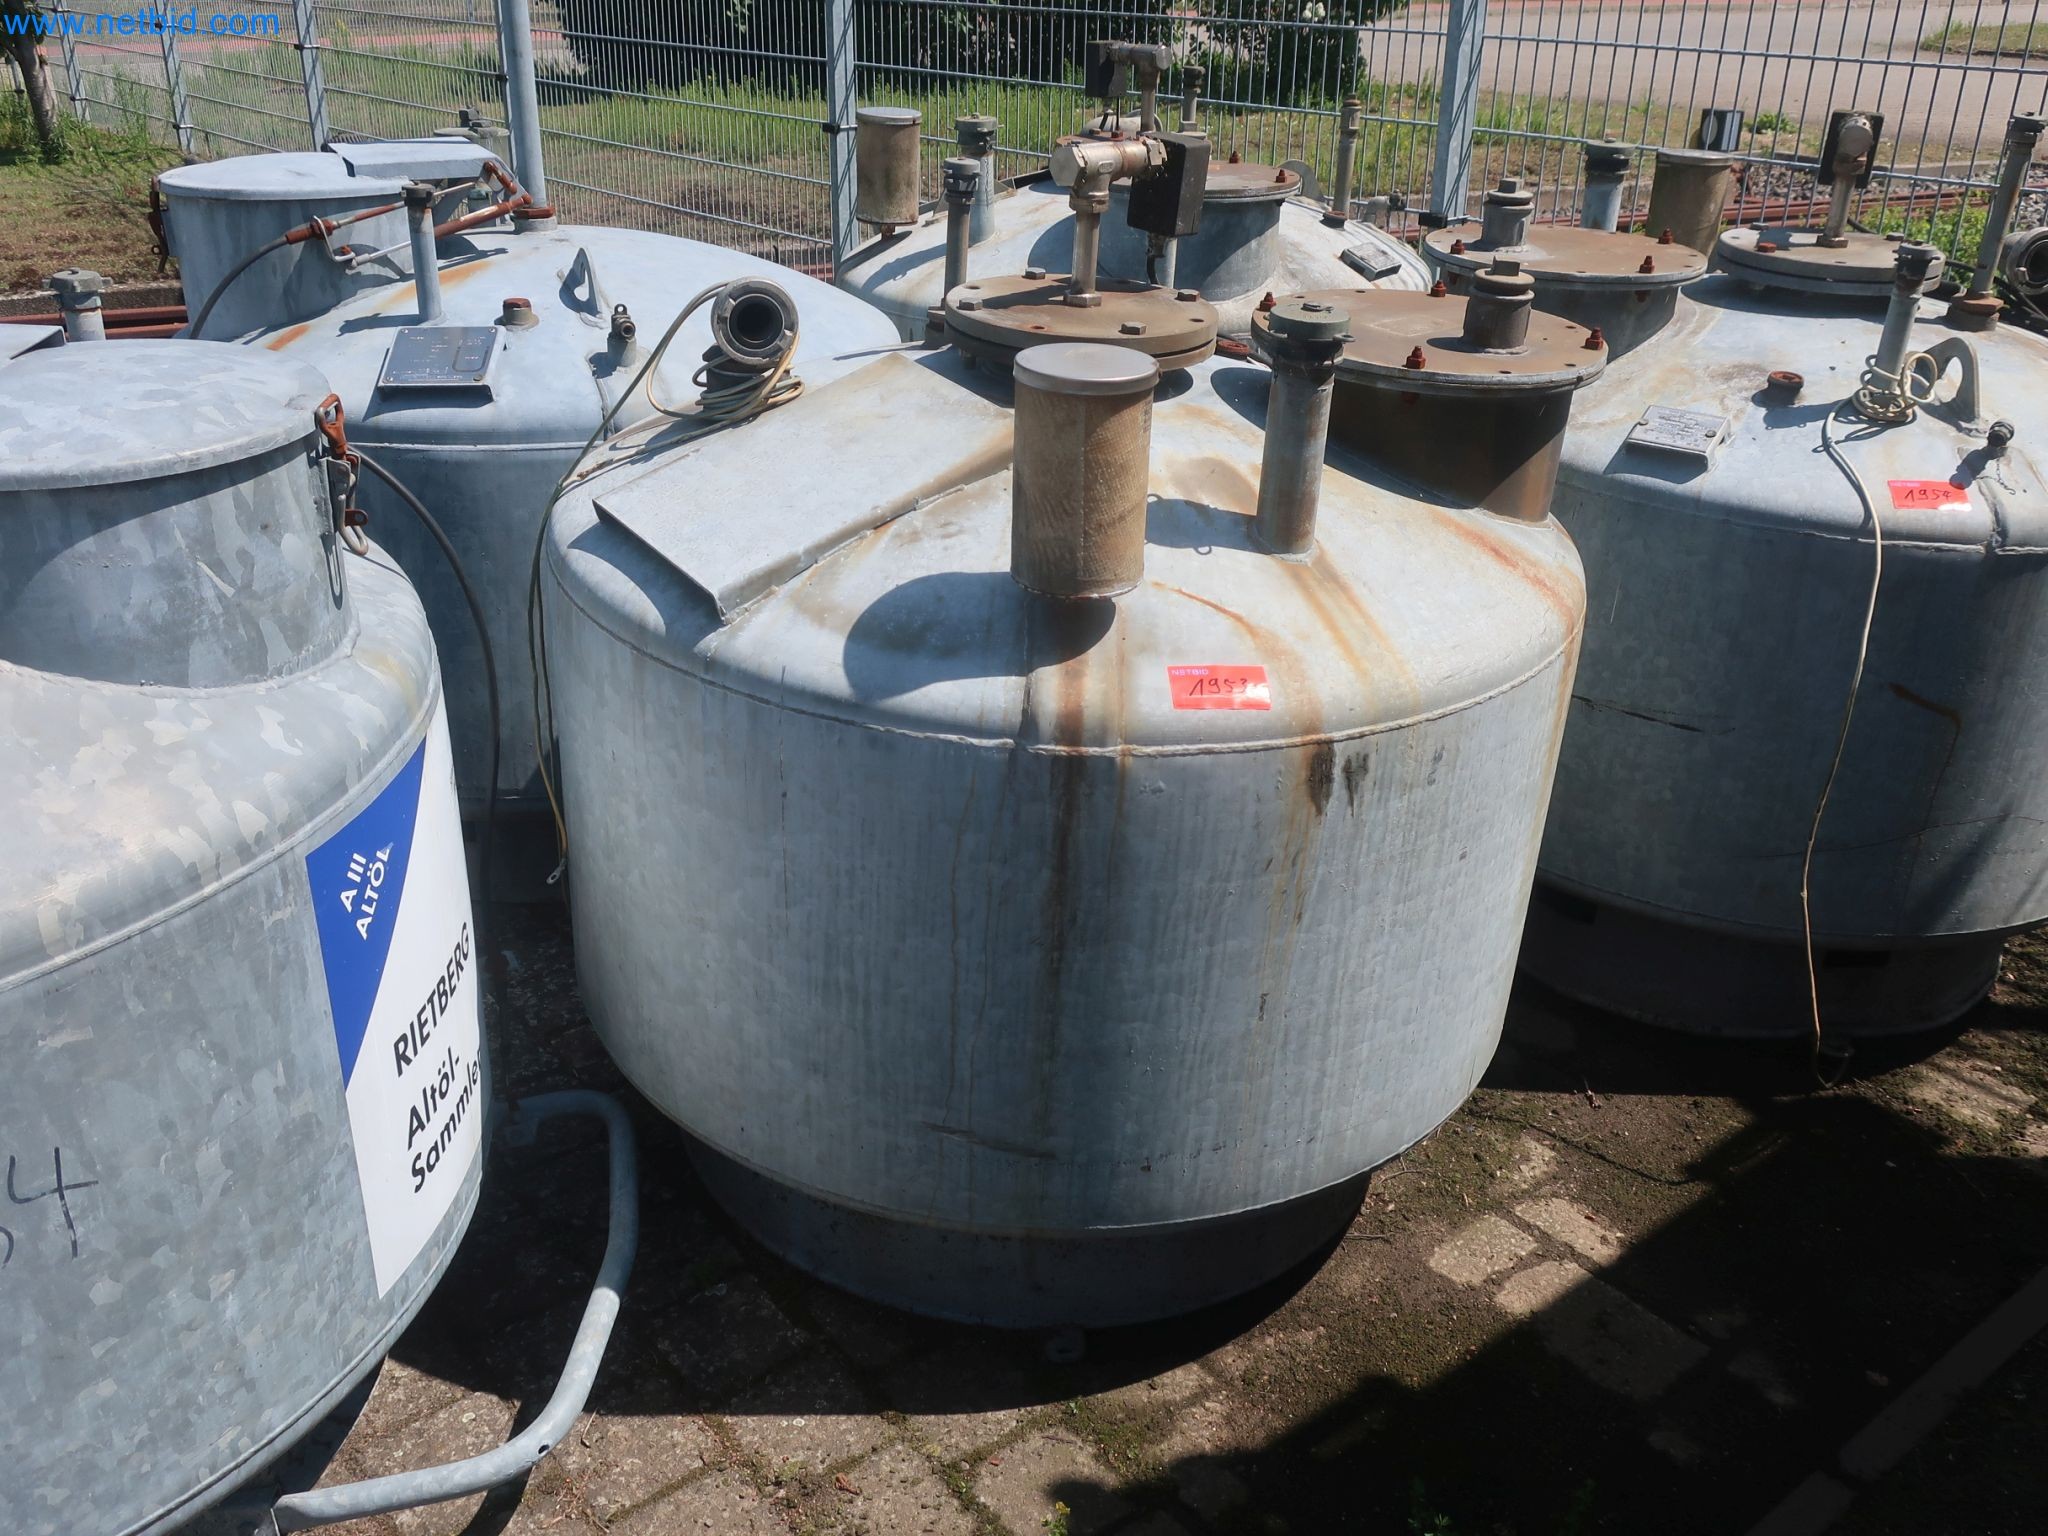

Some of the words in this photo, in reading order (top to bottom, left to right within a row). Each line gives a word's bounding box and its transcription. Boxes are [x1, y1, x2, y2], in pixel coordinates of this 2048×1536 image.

[1904, 488, 1952, 502] 1954
[1189, 677, 1248, 696] 1953
[347, 853, 367, 883] III
[340, 889, 357, 913] A
[356, 842, 394, 940] ALTÖL
[393, 922, 470, 1077] RIETBERG
[407, 1046, 460, 1150] Altöl-
